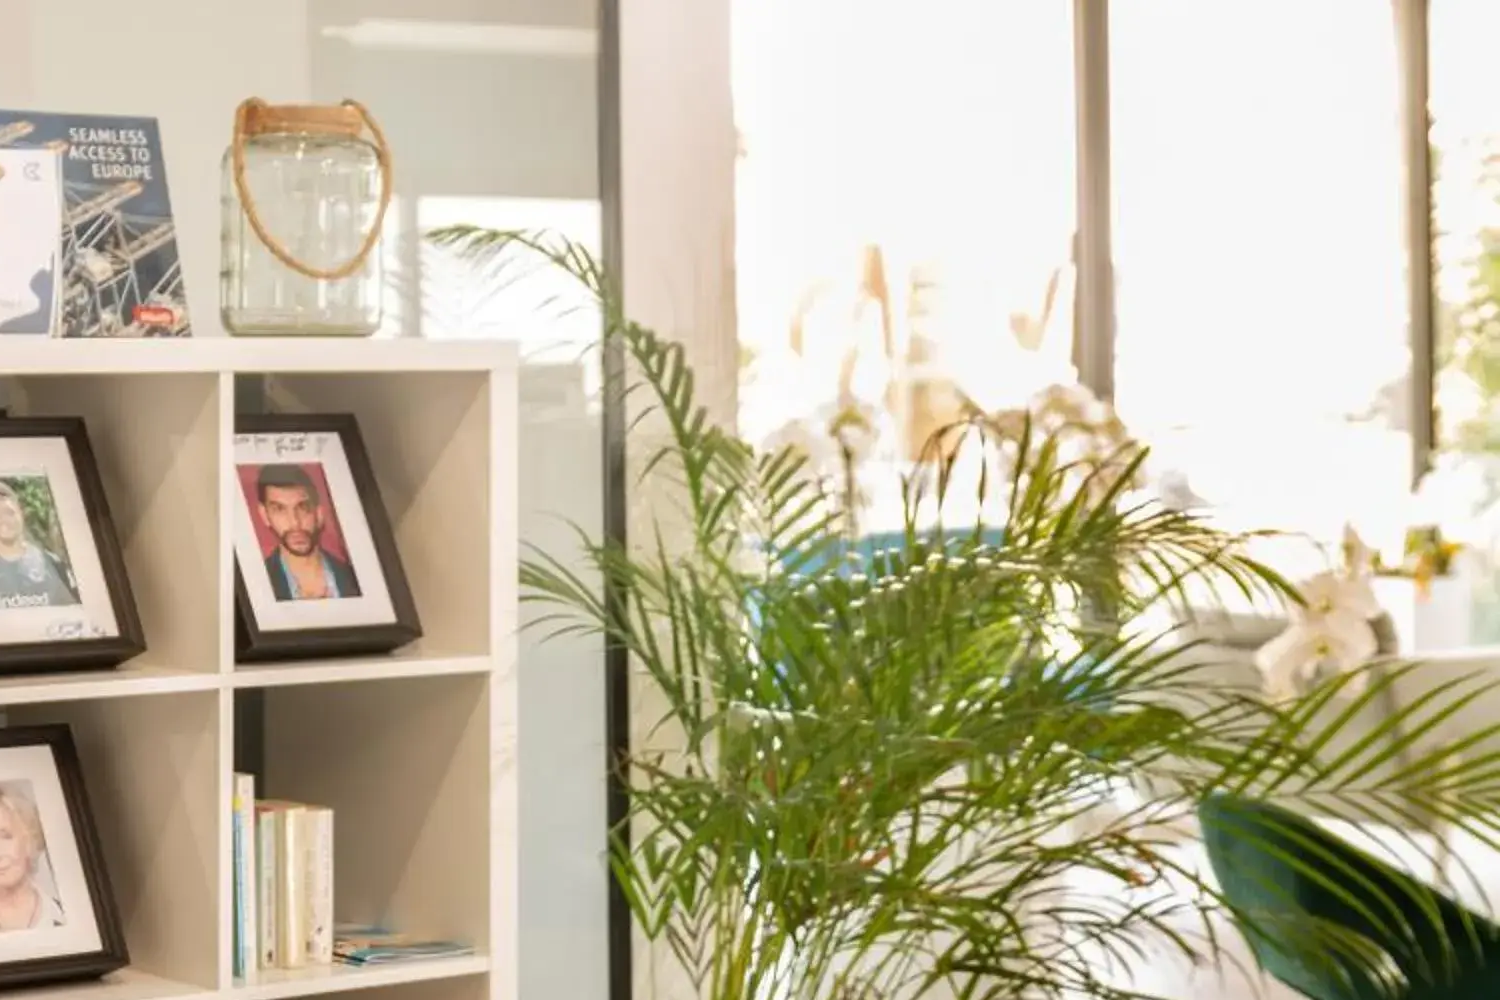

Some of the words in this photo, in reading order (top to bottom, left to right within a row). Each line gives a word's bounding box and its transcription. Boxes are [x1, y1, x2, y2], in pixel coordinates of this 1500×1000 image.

[68, 127, 148, 146] SEAMLESS
[68, 144, 126, 162] ACCESS
[130, 147, 152, 164] TO
[91, 163, 154, 181] EUROPE
